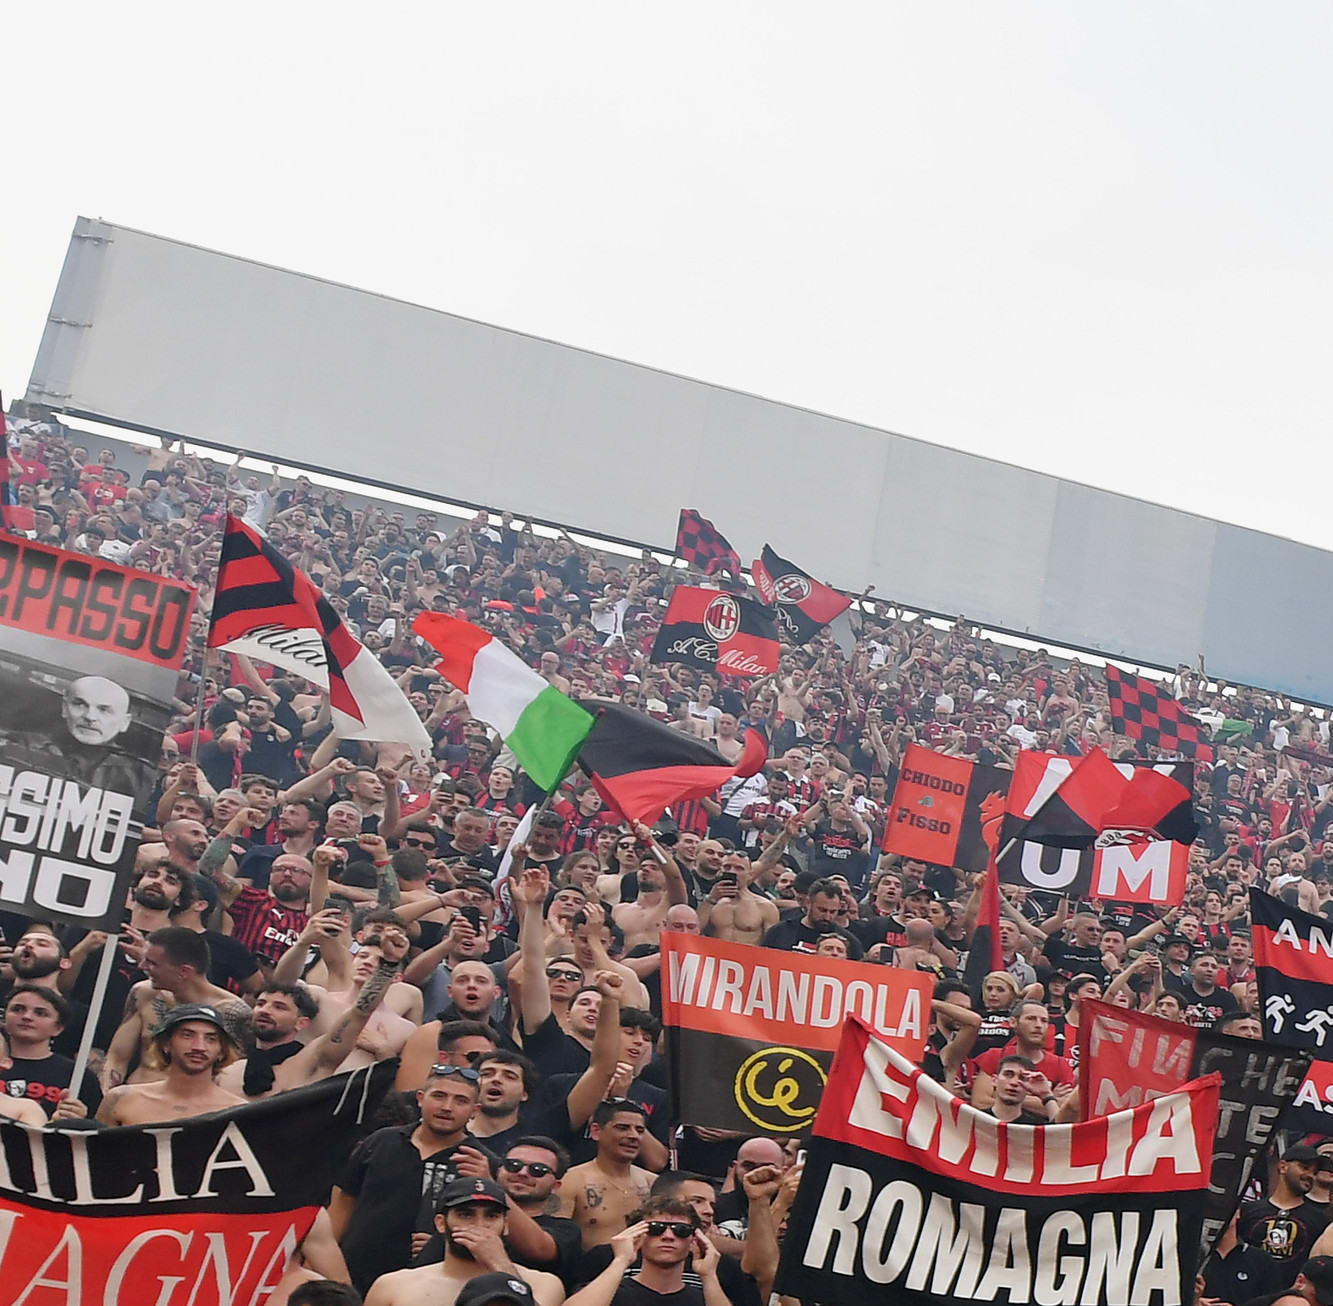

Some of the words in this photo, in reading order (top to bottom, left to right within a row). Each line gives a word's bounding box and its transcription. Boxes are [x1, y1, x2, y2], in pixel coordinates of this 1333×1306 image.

[901, 768, 966, 796] CHIODO
[1021, 840, 1081, 889] U
[1098, 840, 1173, 900] M
[669, 951, 921, 1040] MIRANDOLA
[848, 1033, 1201, 1185] EMILIA
[803, 1163, 1182, 1306] ROMAGNA
